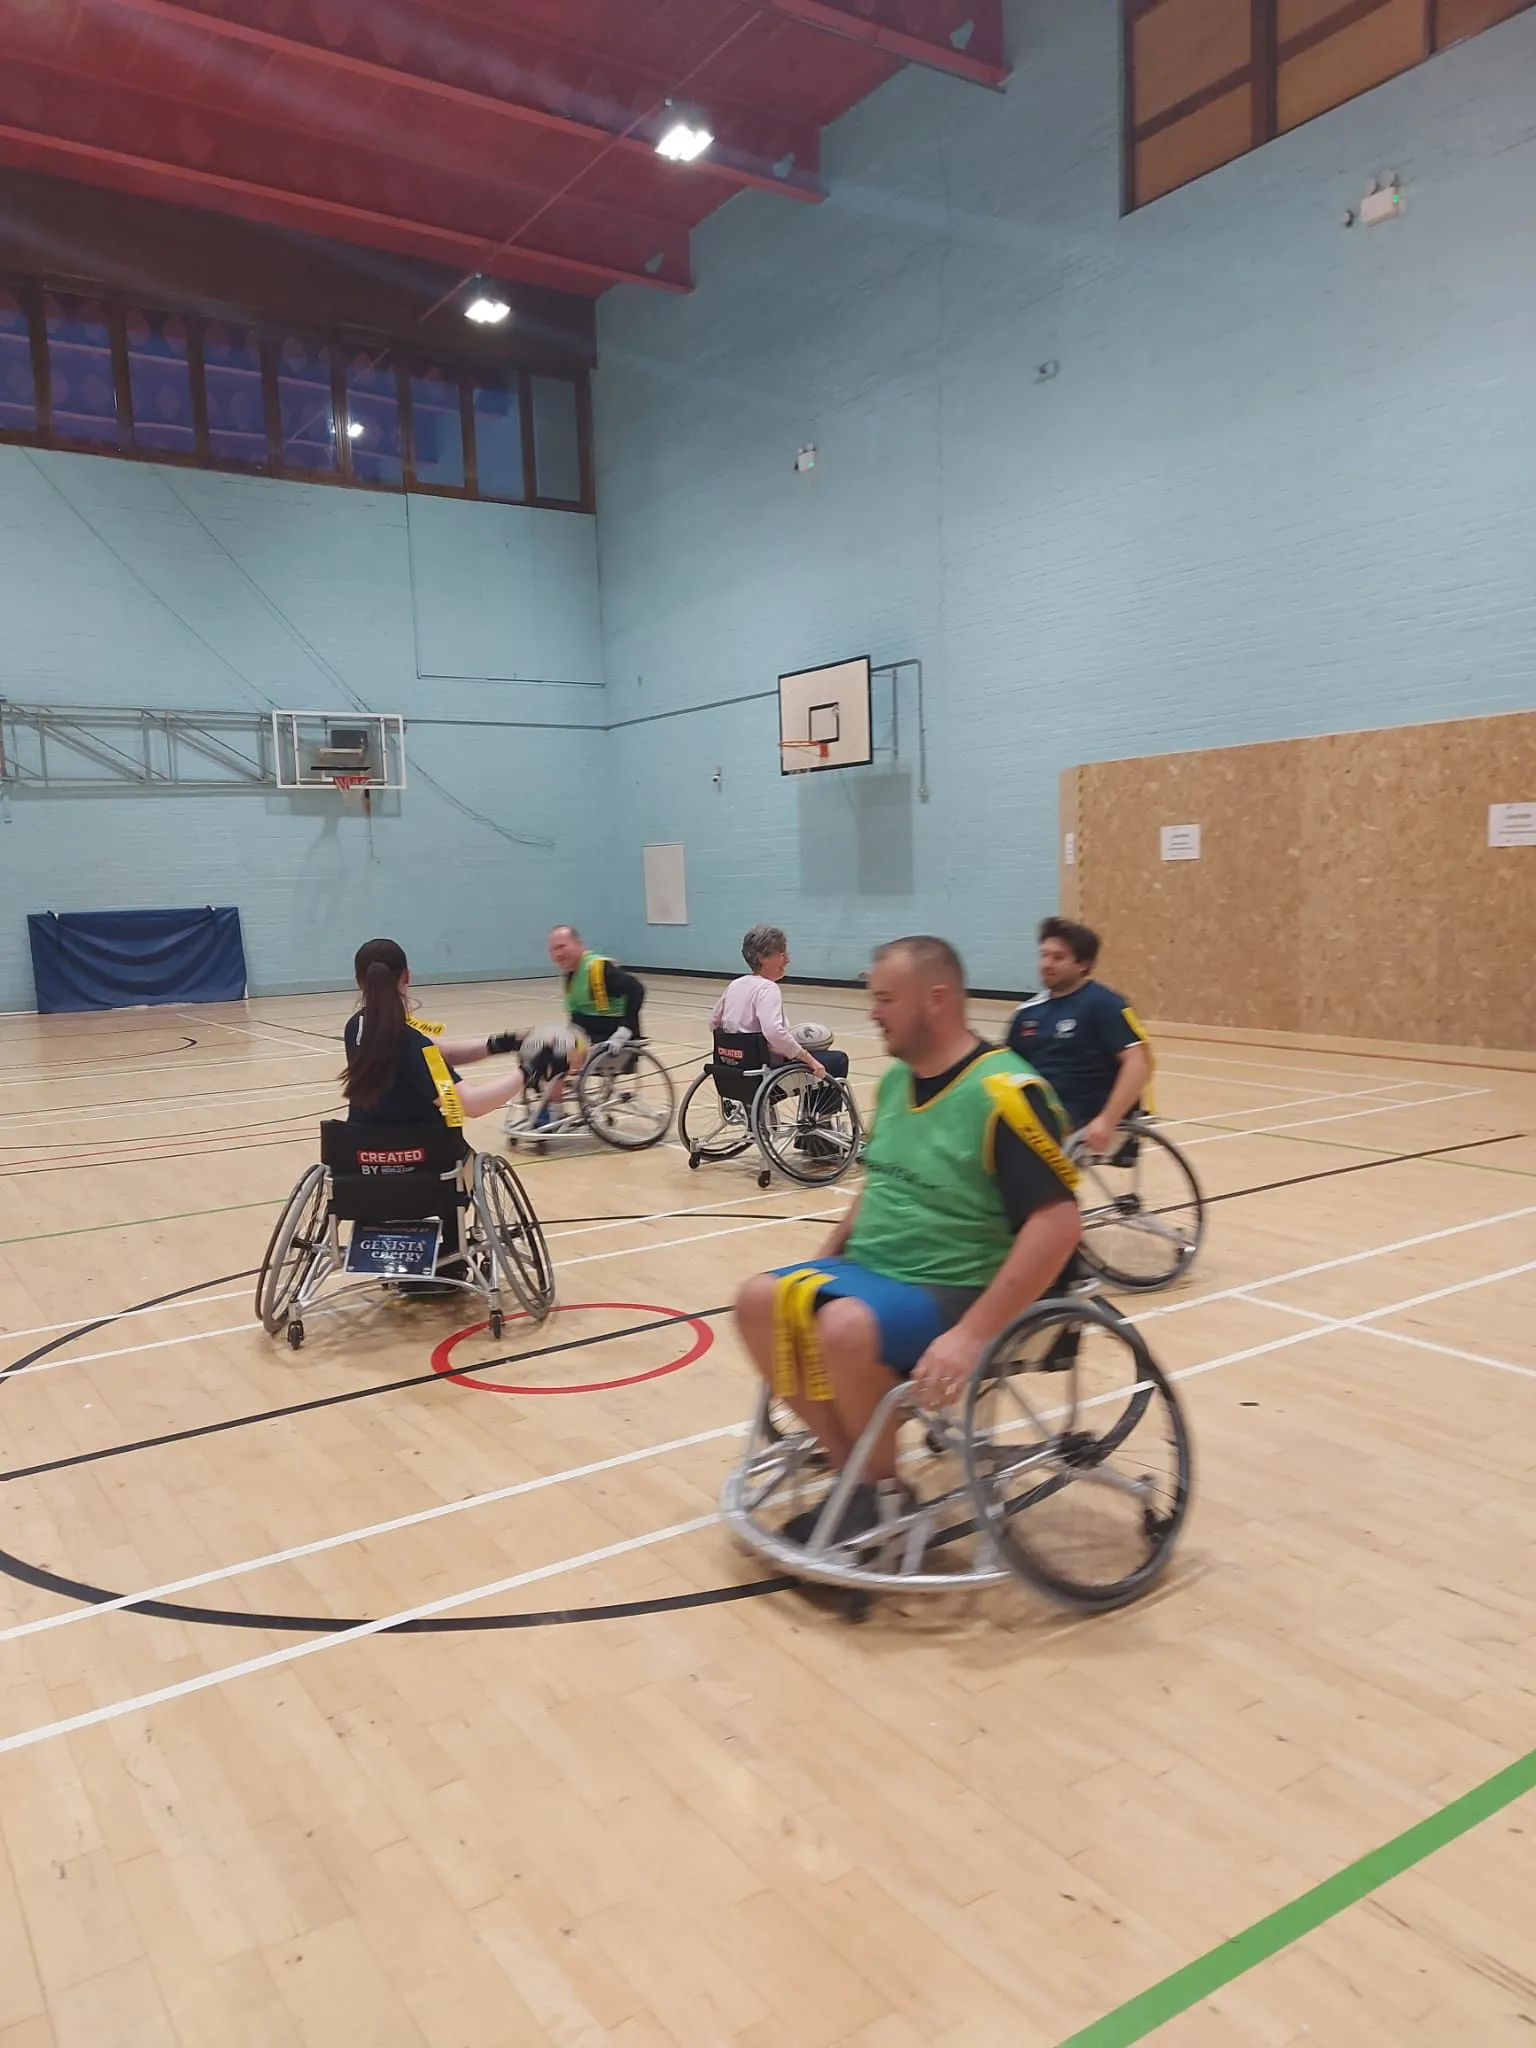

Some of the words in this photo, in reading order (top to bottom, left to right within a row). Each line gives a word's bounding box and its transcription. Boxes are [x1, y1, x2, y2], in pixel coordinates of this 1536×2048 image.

[360, 1150, 423, 1163] CREATED
[361, 1165, 379, 1175] BY
[360, 1239, 424, 1252] GENISTA
